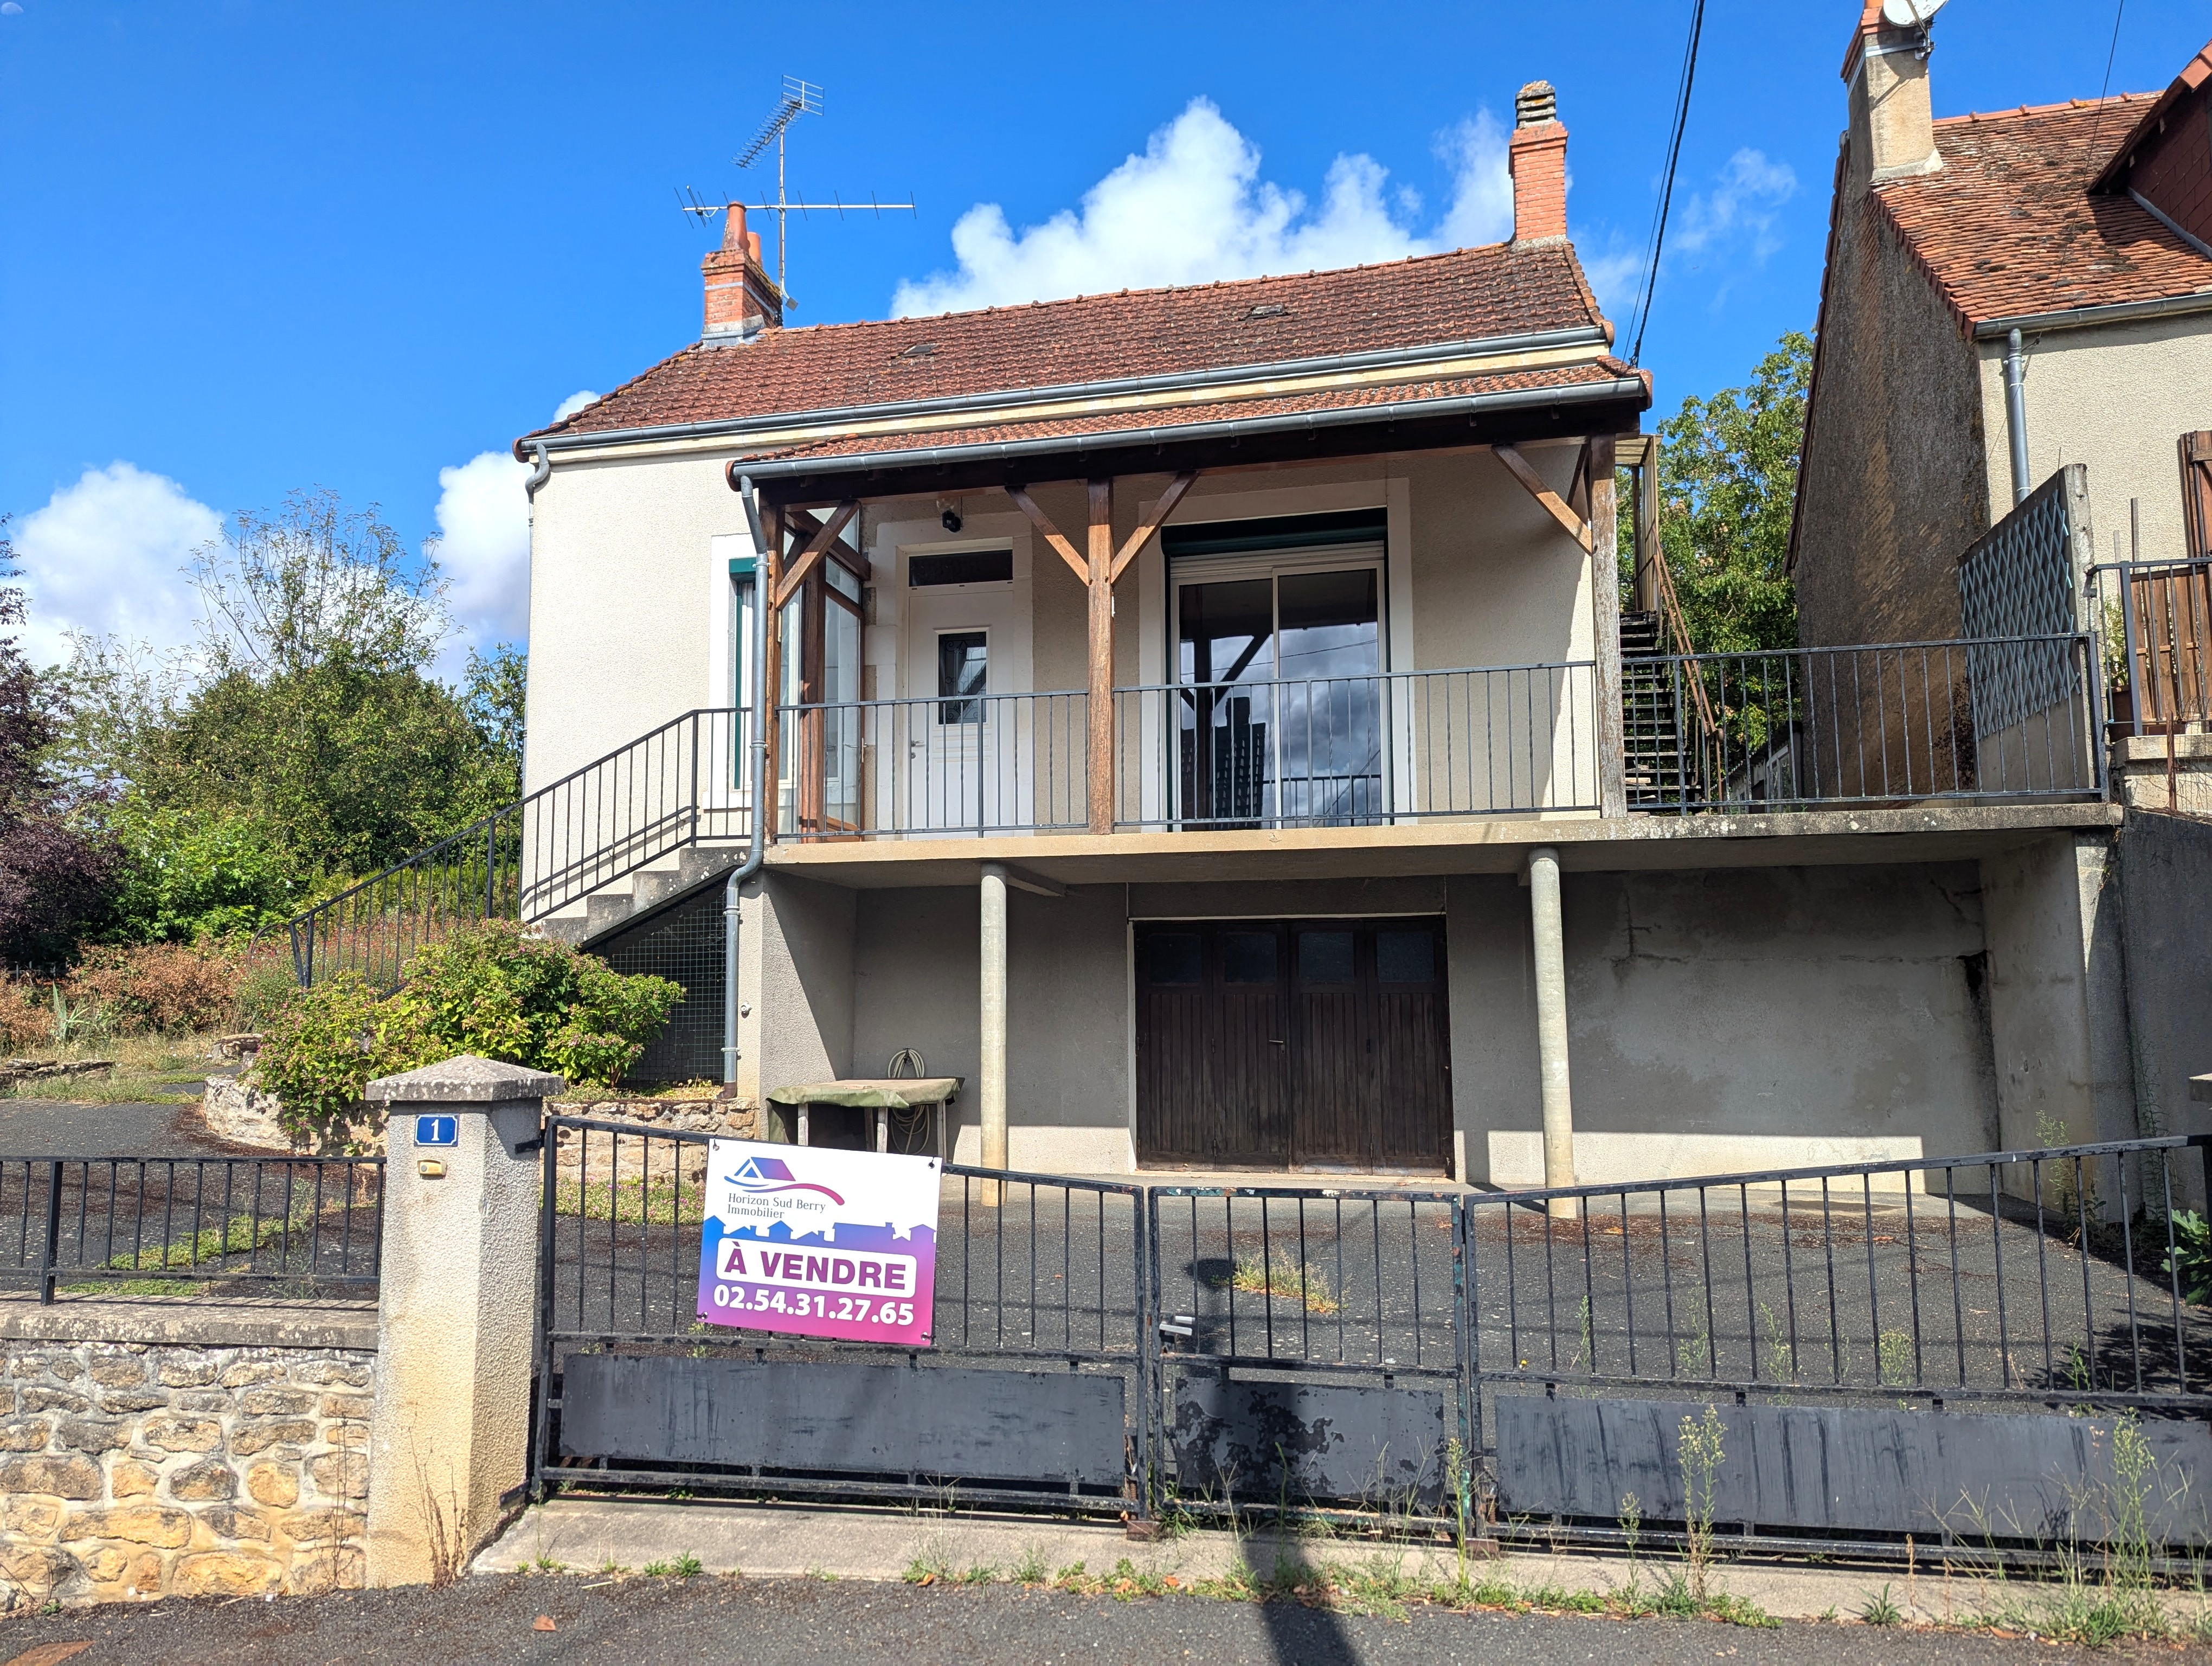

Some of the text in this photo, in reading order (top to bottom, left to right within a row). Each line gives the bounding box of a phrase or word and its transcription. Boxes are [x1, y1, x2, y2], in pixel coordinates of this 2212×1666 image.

[431, 1119, 440, 1141] 1
[727, 1204, 785, 1219] Immobilier
[728, 1193, 826, 1214] Horizon Sud Berry
[724, 1241, 906, 1290] À VENDRE
[713, 1284, 914, 1325] 02.54.31.27.65
